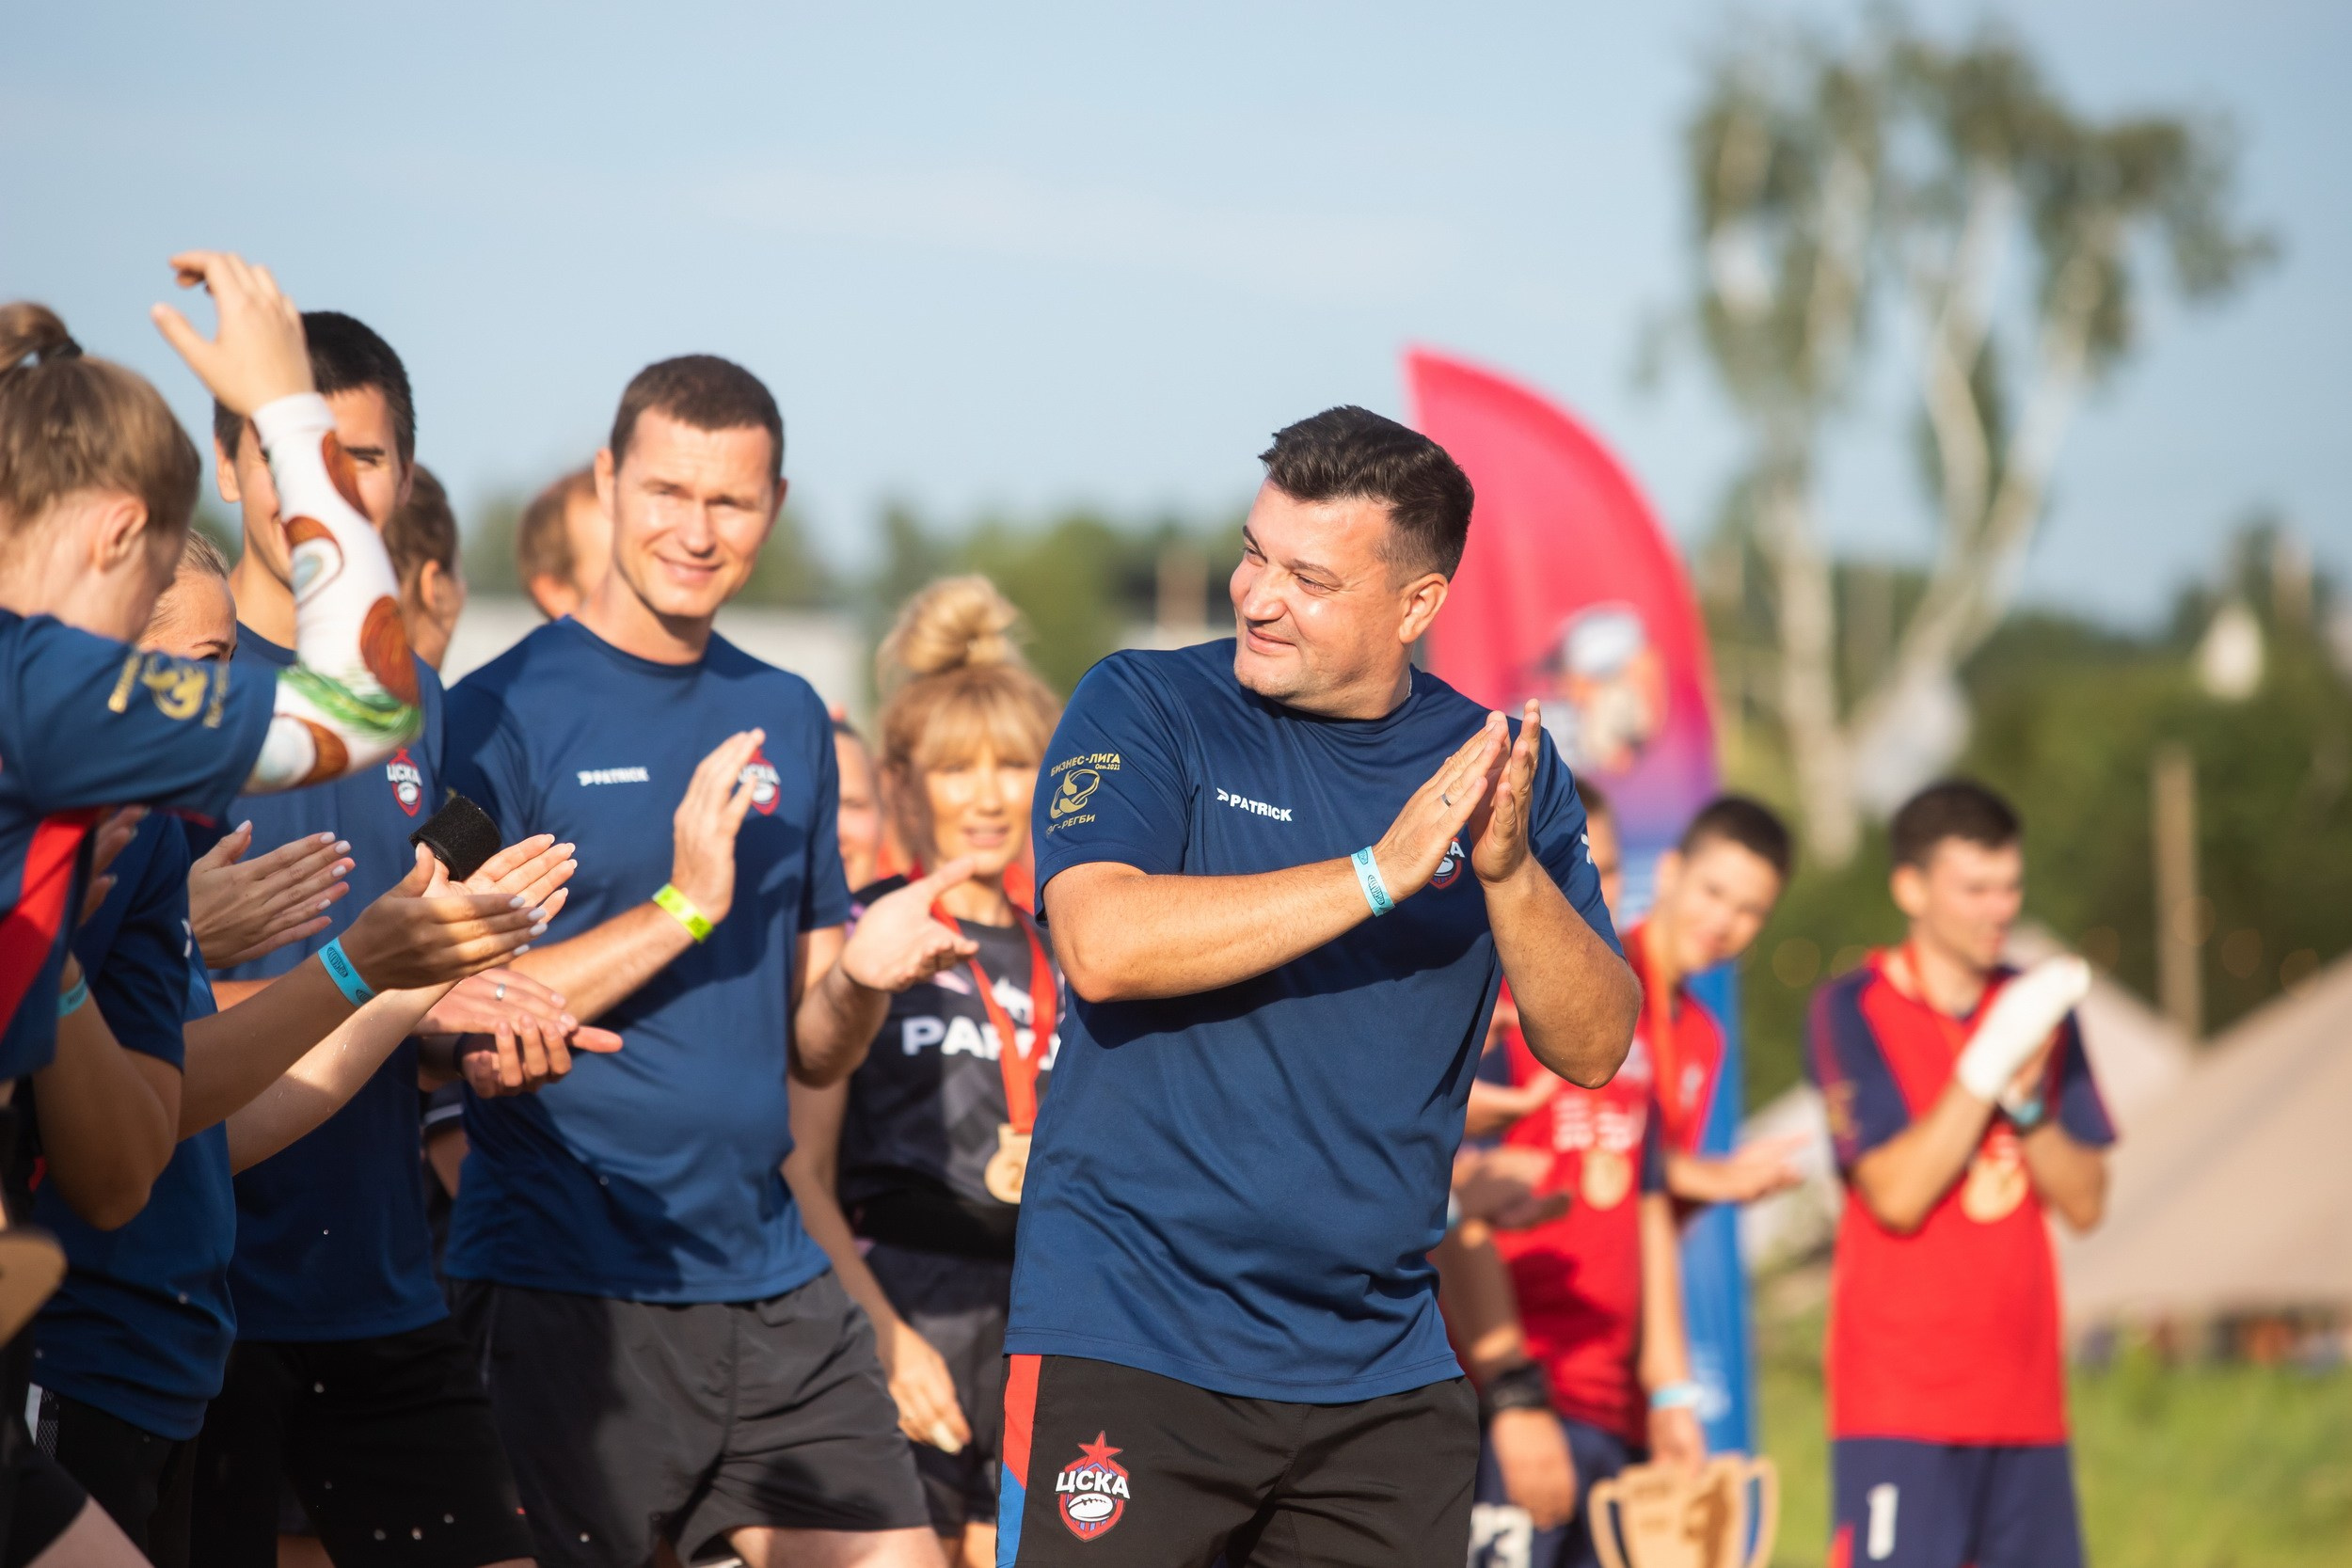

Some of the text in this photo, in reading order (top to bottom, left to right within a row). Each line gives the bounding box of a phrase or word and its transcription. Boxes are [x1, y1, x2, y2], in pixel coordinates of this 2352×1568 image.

[1050, 753, 1120, 777] БИЗНЕС-ЛИГА
[1230, 794, 1293, 821] PATRICK
[1055, 1470, 1131, 1499] ЦСКА
[1867, 1481, 1899, 1560] 1
